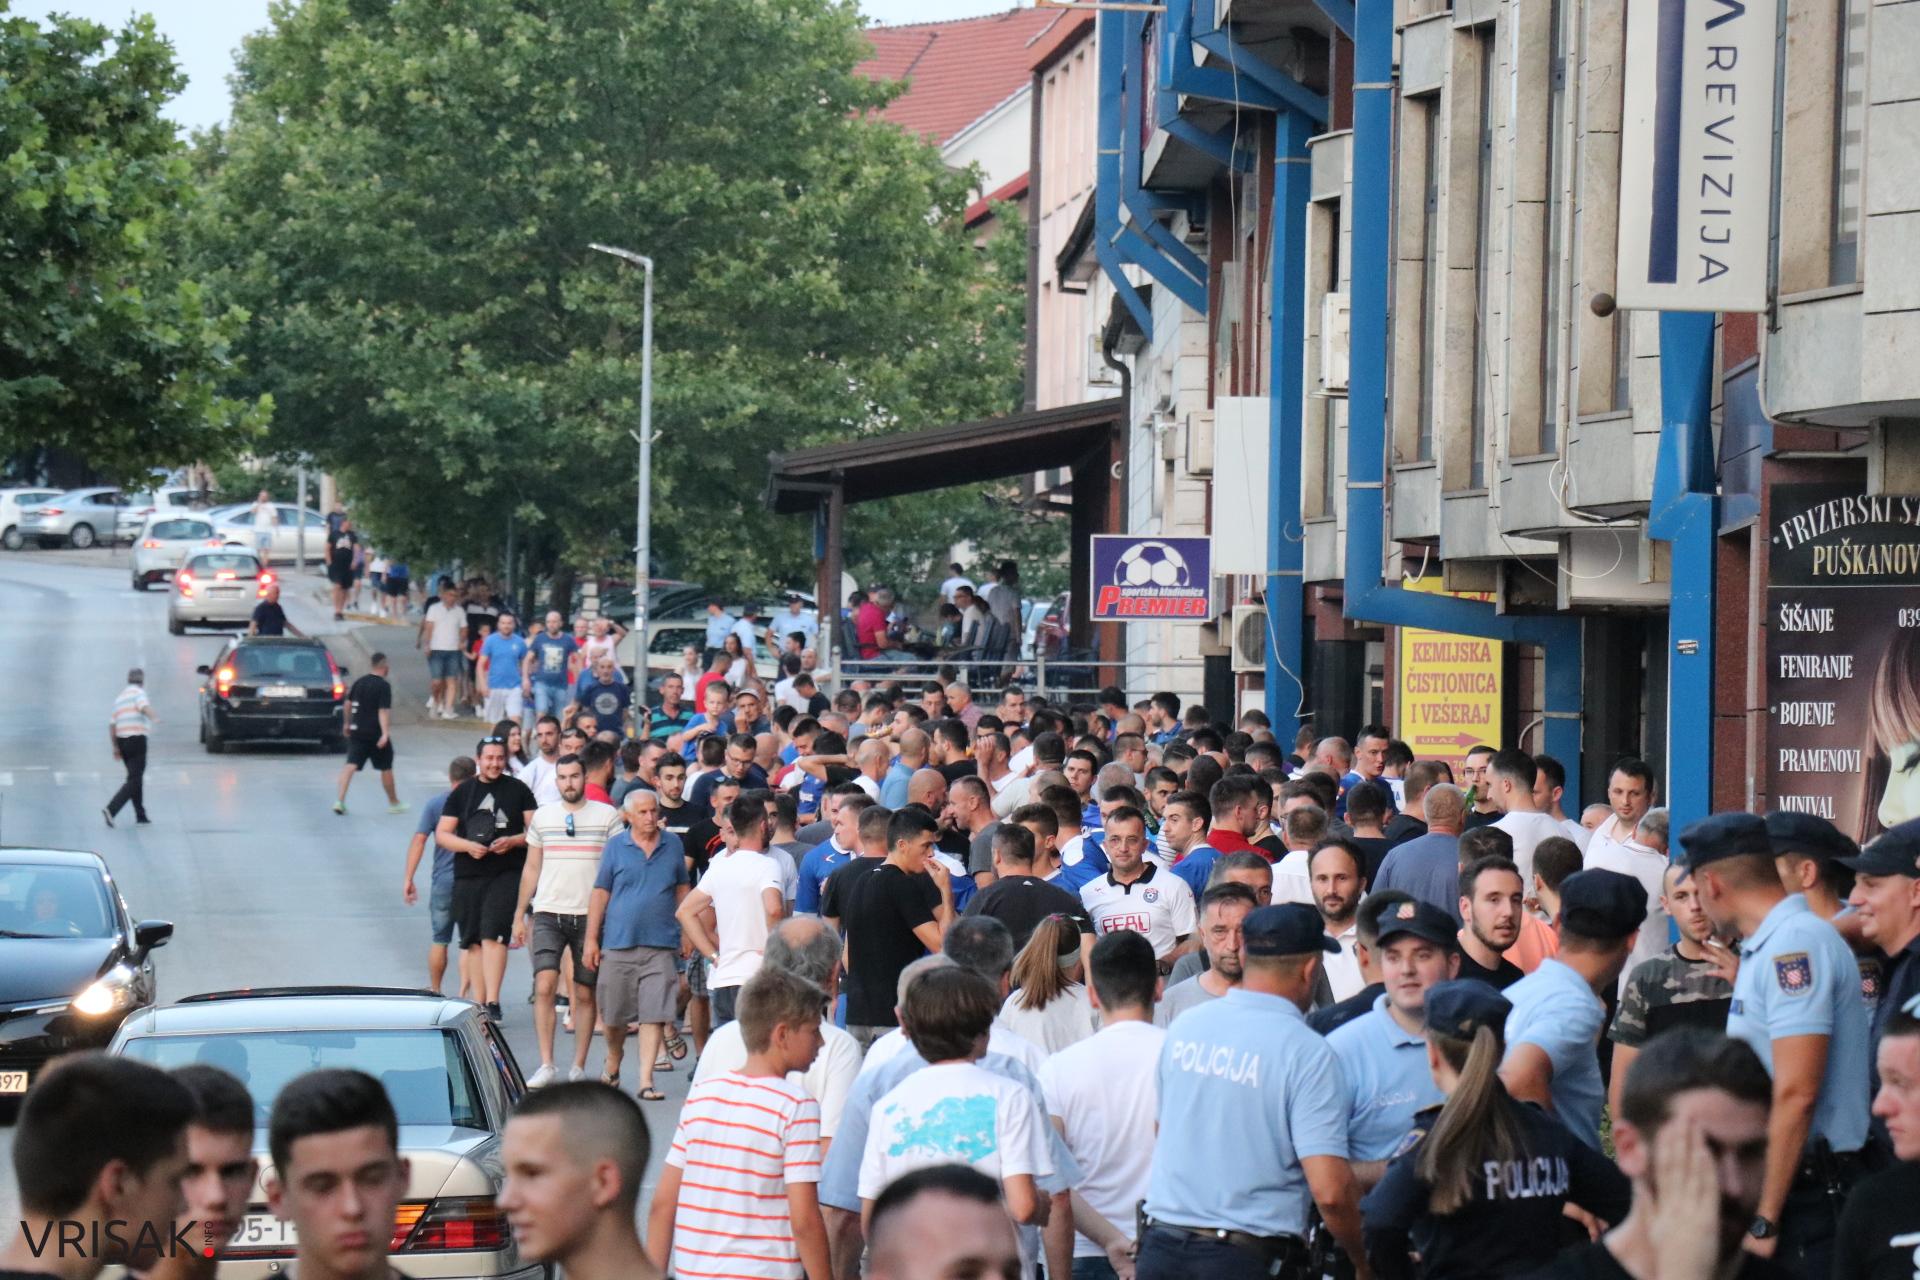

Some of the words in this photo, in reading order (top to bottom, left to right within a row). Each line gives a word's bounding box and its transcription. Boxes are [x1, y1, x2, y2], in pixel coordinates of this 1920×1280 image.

[1780, 494, 1891, 550] FRIZERSKI
[1812, 537, 1920, 576] PUŠKANOV
[1780, 603, 1834, 633] ŠIŠANJE
[1412, 642, 1492, 663] KEMIJSKA
[1406, 667, 1497, 694] ČISTIONICA
[1780, 655, 1853, 680] FENIRANJE
[1411, 703, 1417, 724] I
[1421, 697, 1491, 724] VEŠERAJ
[1780, 702, 1836, 727] BOJENJE
[1779, 749, 1862, 773] PRAMENOVI
[1171, 1040, 1260, 1088] POLICIJA
[0, 1074, 23, 1090] 97
[1484, 1156, 1569, 1200] POLICIJA
